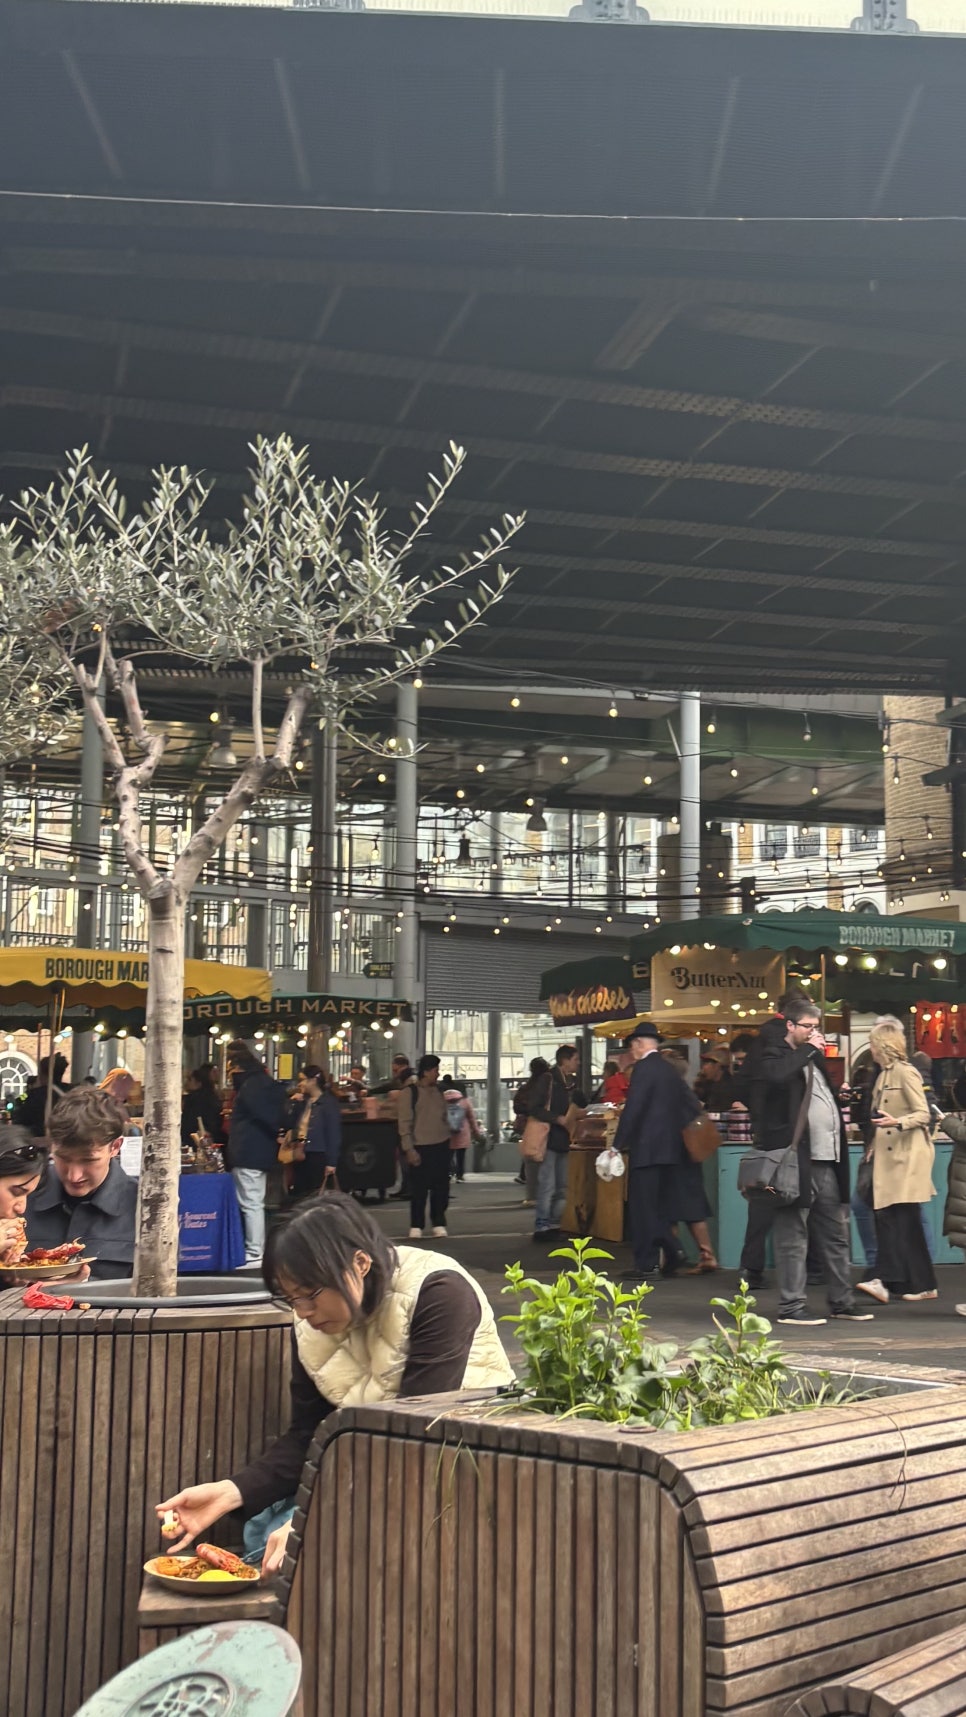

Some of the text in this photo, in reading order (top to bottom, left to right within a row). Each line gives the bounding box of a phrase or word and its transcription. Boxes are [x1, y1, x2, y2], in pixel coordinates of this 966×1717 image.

[839, 926, 956, 948] BOROUGH MARKET
[45, 958, 149, 982] BOROUGH MAR
[183, 1000, 407, 1020] OROUGH MARKET
